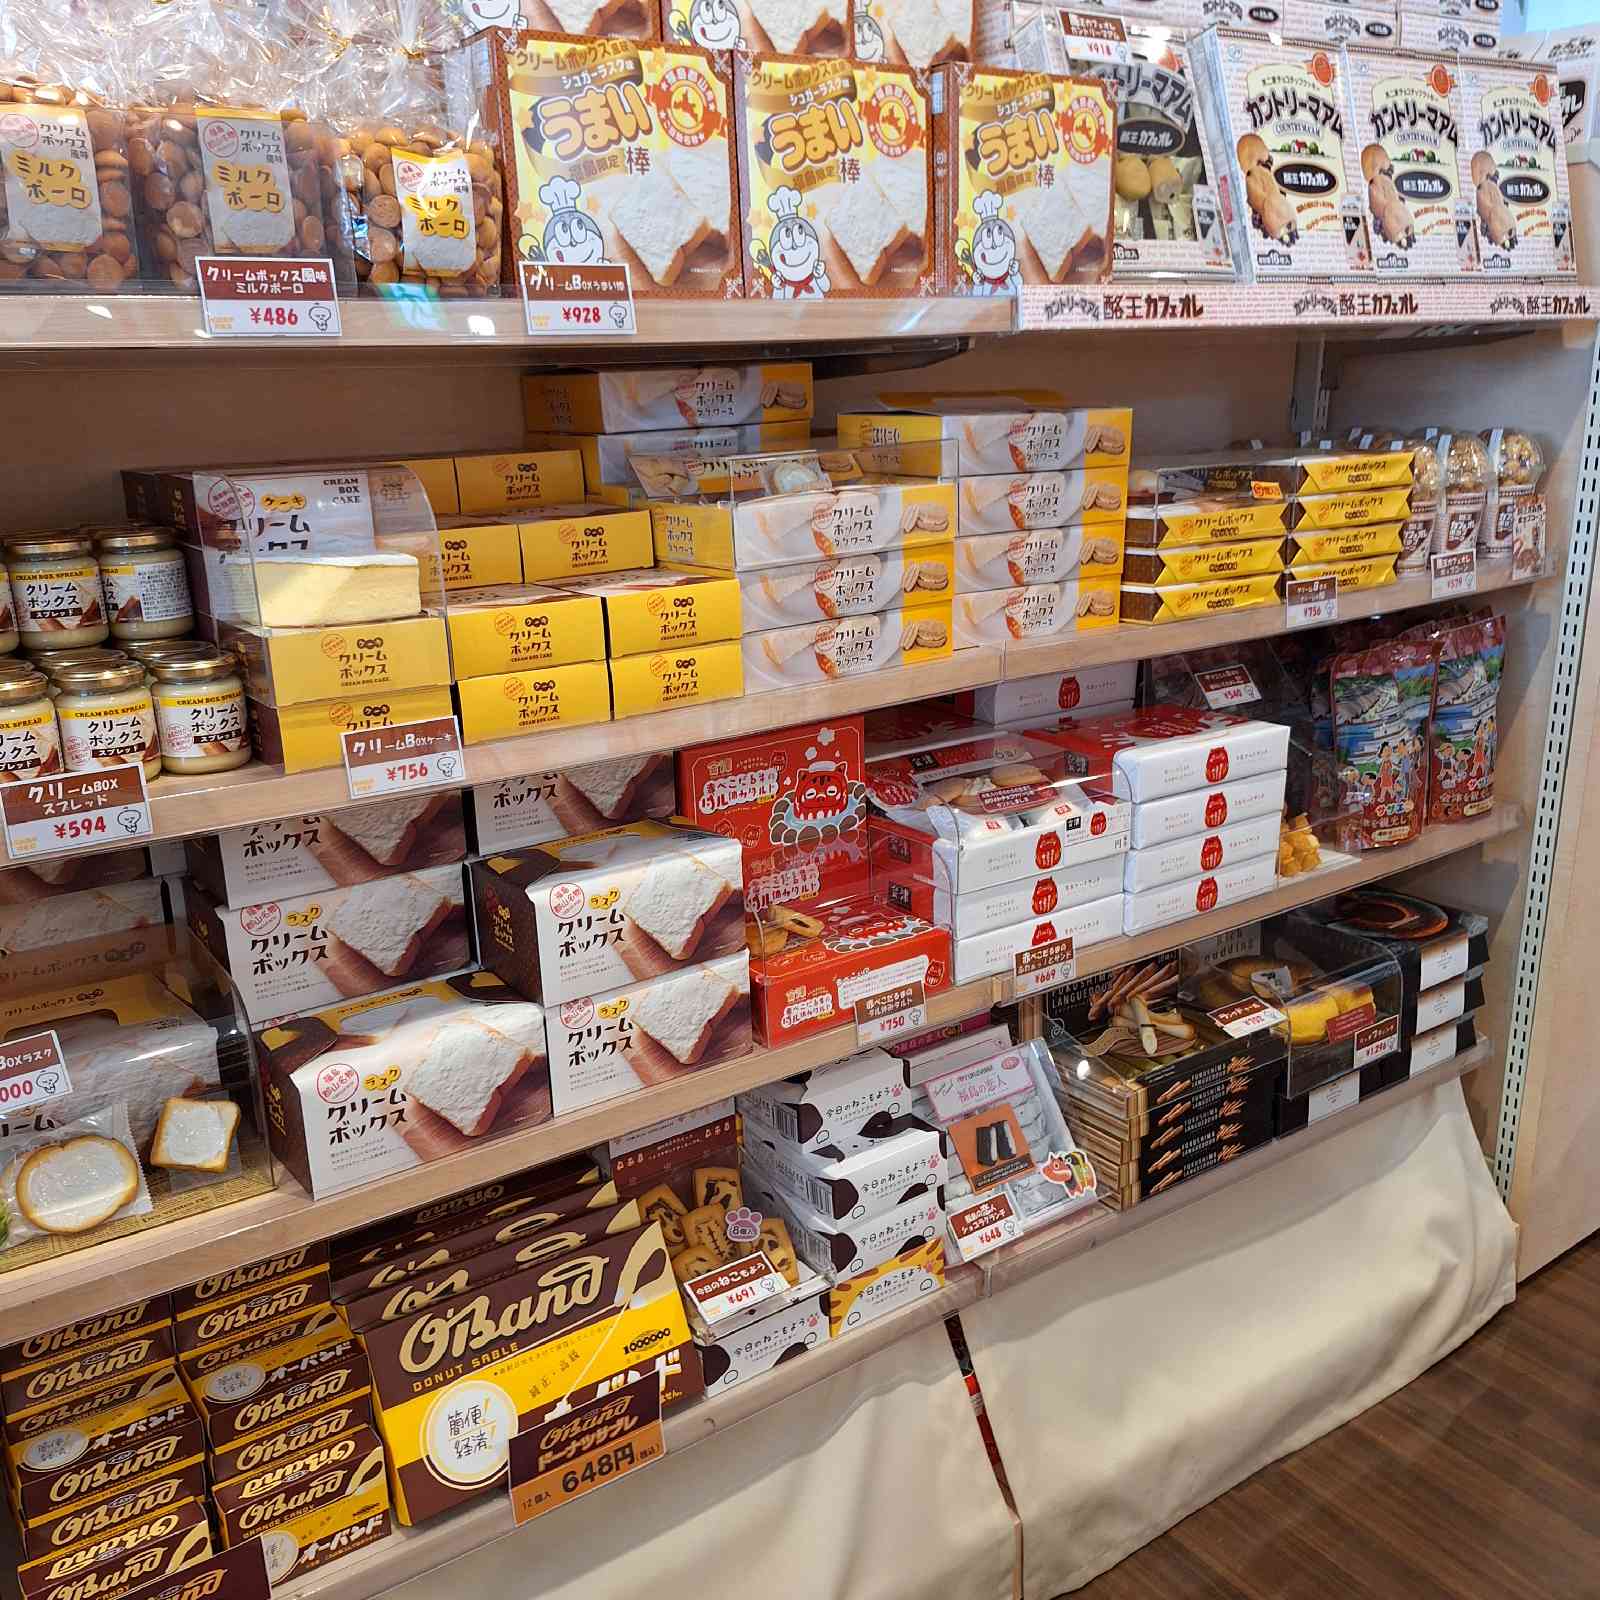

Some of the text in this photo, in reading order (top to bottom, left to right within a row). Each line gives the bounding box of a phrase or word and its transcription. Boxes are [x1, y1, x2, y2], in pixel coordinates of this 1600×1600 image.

[541, 84, 653, 160] うまい
[1245, 90, 1343, 140] カントリーマアム
[40, 123, 86, 139] クリーム
[1370, 101, 1458, 149] カントリーマアム
[1480, 110, 1556, 154] カントリーマアム
[41, 135, 88, 151] ボックス
[240, 129, 281, 142] クリーム
[770, 99, 862, 173] うまい
[240, 141, 281, 154] ボックス
[979, 111, 1058, 179] うまい
[16, 154, 76, 178] ミルク
[626, 146, 650, 176] 棒
[216, 164, 271, 185] ミルク
[840, 156, 860, 184] 棒
[1039, 164, 1055, 189] 棒
[27, 180, 86, 203] ボーロ
[227, 187, 281, 207] ボーロ
[411, 196, 460, 211] ミルク
[419, 217, 466, 234] ボーロ
[206, 266, 328, 284] クリームボックス風味
[235, 282, 305, 295] ミルクボーロ
[1103, 292, 1205, 321] 酪王カフェオレ
[1339, 292, 1419, 317] 酪王カフェオレ
[1526, 295, 1591, 316] 酪王カフェオレ
[250, 307, 299, 327] ¥486
[562, 306, 601, 323] ¥928
[1026, 424, 1062, 436] クリーム
[1026, 438, 1060, 451] ボックス
[1334, 461, 1387, 474] クリームボックス
[323, 477, 359, 487] CREAM
[505, 474, 540, 485] クリーム
[338, 486, 361, 495] BOX
[505, 484, 541, 496] ボックス
[1026, 483, 1060, 496] クリーム
[263, 495, 304, 508] ケーキ
[1026, 497, 1059, 510] ボックス
[1330, 497, 1383, 510] クリームボックス
[832, 505, 874, 520] クリーム
[1194, 513, 1254, 527] クリームボックス
[833, 520, 873, 536] ボックス
[570, 538, 608, 549] クリーム
[1024, 540, 1058, 552] クリーム
[1325, 532, 1377, 545] クリームボックス
[571, 549, 608, 562] ボックス
[1024, 554, 1057, 566] ボックス
[1194, 548, 1253, 563] クリームボックス
[834, 565, 875, 581] クリーム
[26, 582, 78, 596] クリーム
[835, 581, 874, 596] ボックス
[1192, 585, 1251, 600] クリームボックス
[28, 595, 80, 609] ボックス
[1023, 594, 1055, 606] クリーム
[660, 609, 697, 621] クリーム
[1022, 607, 1054, 619] ボックス
[508, 629, 551, 641] クリーム
[660, 621, 697, 634] ボックス
[835, 626, 875, 642] クリーム
[511, 641, 552, 655] ボックス
[836, 641, 873, 656] ボックス
[338, 651, 388, 664] クリーム
[339, 664, 388, 680] ボックス
[662, 670, 698, 682] クリーム
[662, 681, 699, 695] ボックス
[517, 694, 559, 706] クリーム
[190, 704, 240, 721] クリーム
[518, 704, 560, 719] ボックス
[87, 716, 142, 734] クリーム
[191, 716, 241, 734] ボックス
[89, 730, 144, 747] ボックス
[353, 733, 454, 756] クリームBOXケーキ
[98, 745, 140, 757] スプレッド
[386, 762, 429, 782] ¥756
[28, 778, 119, 802] クリームBOX
[493, 783, 560, 809] ボックス
[42, 794, 109, 816] スプレッド
[53, 816, 107, 839] ¥594
[243, 829, 321, 858] ボックス
[590, 889, 620, 908] ラスク
[288, 906, 321, 924] ラスク
[556, 908, 626, 937] クリーム
[250, 925, 329, 953] クリーム
[559, 927, 626, 958] ボックス
[252, 945, 329, 976] ボックス
[1035, 970, 1056, 983] ¥669
[599, 1000, 628, 1016] ラスク
[567, 1017, 634, 1047] クリーム
[880, 1016, 905, 1031] ¥750
[568, 1035, 634, 1068] ボックス
[364, 1068, 399, 1088] ラスク
[327, 1087, 408, 1122] クリーム
[826, 1087, 891, 1120] 今日のねこもよう
[329, 1107, 408, 1146] ボックス
[861, 1160, 926, 1192] 今日のねこもよう
[860, 1211, 924, 1248] 今日のねこもよう
[979, 1228, 1003, 1245] ¥648
[696, 1261, 767, 1296] 今日のねこもよう
[859, 1264, 923, 1298] 今日のねこもよう
[727, 1286, 757, 1305] ¥691
[734, 1317, 806, 1357] 今日のねこもよう
[270, 1341, 352, 1382] オーバンド
[412, 1363, 465, 1393] DONUT
[471, 1342, 519, 1368] SABLE
[89, 1405, 186, 1450] オーバンド
[521, 1490, 551, 1511] 12個入
[562, 1442, 635, 1493] 648円
[301, 1514, 384, 1564] オーバンド
